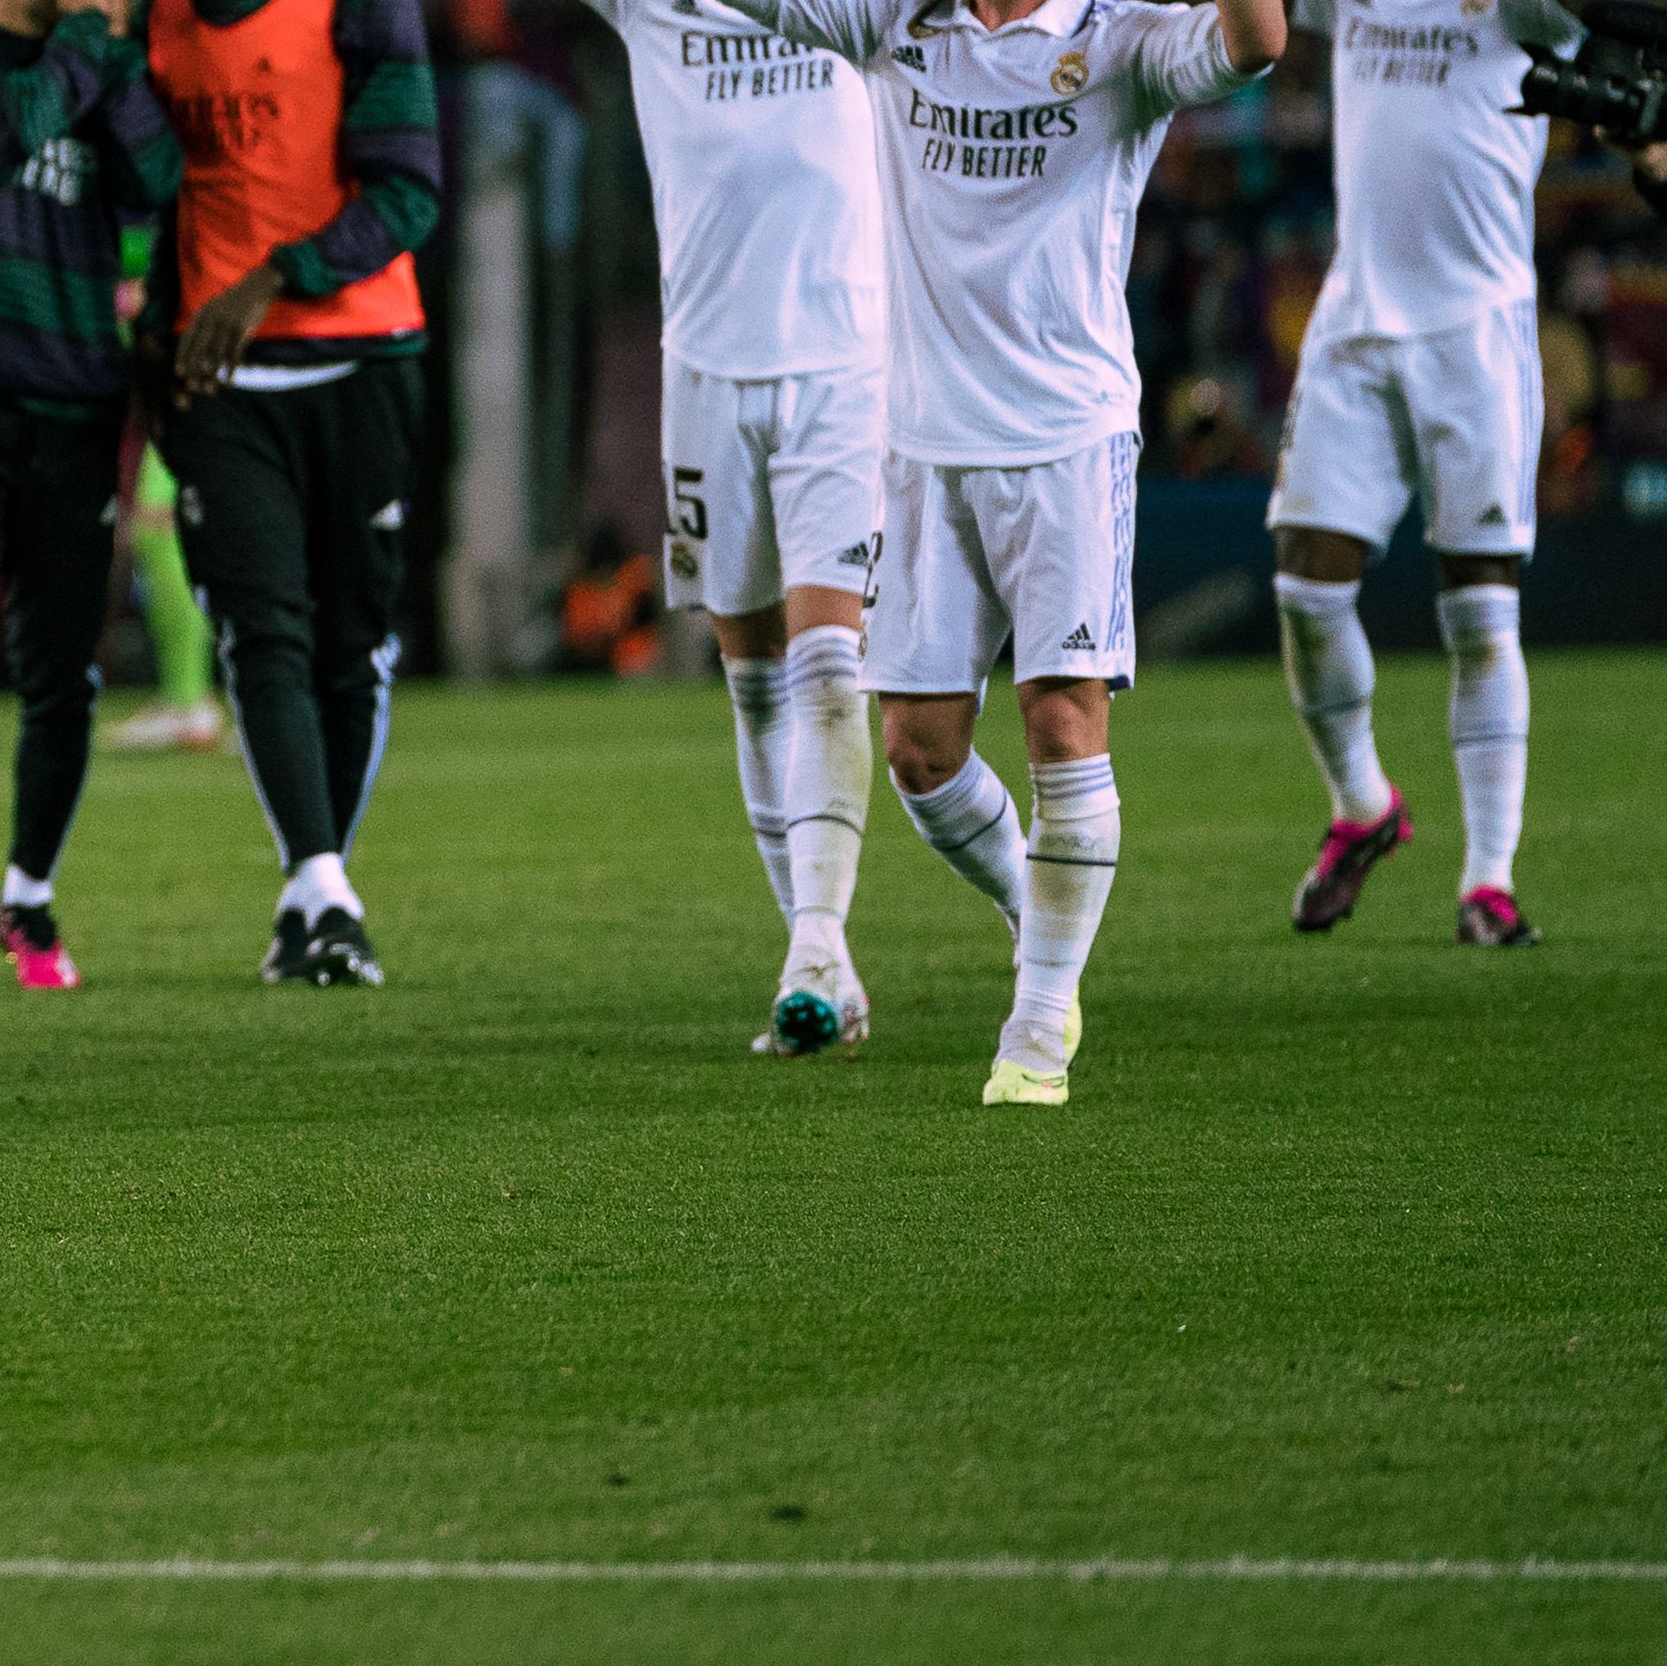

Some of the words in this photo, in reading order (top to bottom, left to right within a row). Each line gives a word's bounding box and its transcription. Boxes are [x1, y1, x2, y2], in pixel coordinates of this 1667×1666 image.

[682, 30, 813, 67] Emira
[706, 70, 741, 101] FLY
[751, 59, 834, 97] BETTER
[909, 88, 1078, 141] Emirates
[922, 138, 956, 172] FLY
[962, 145, 1047, 179] BETTER
[665, 466, 707, 541] 5
